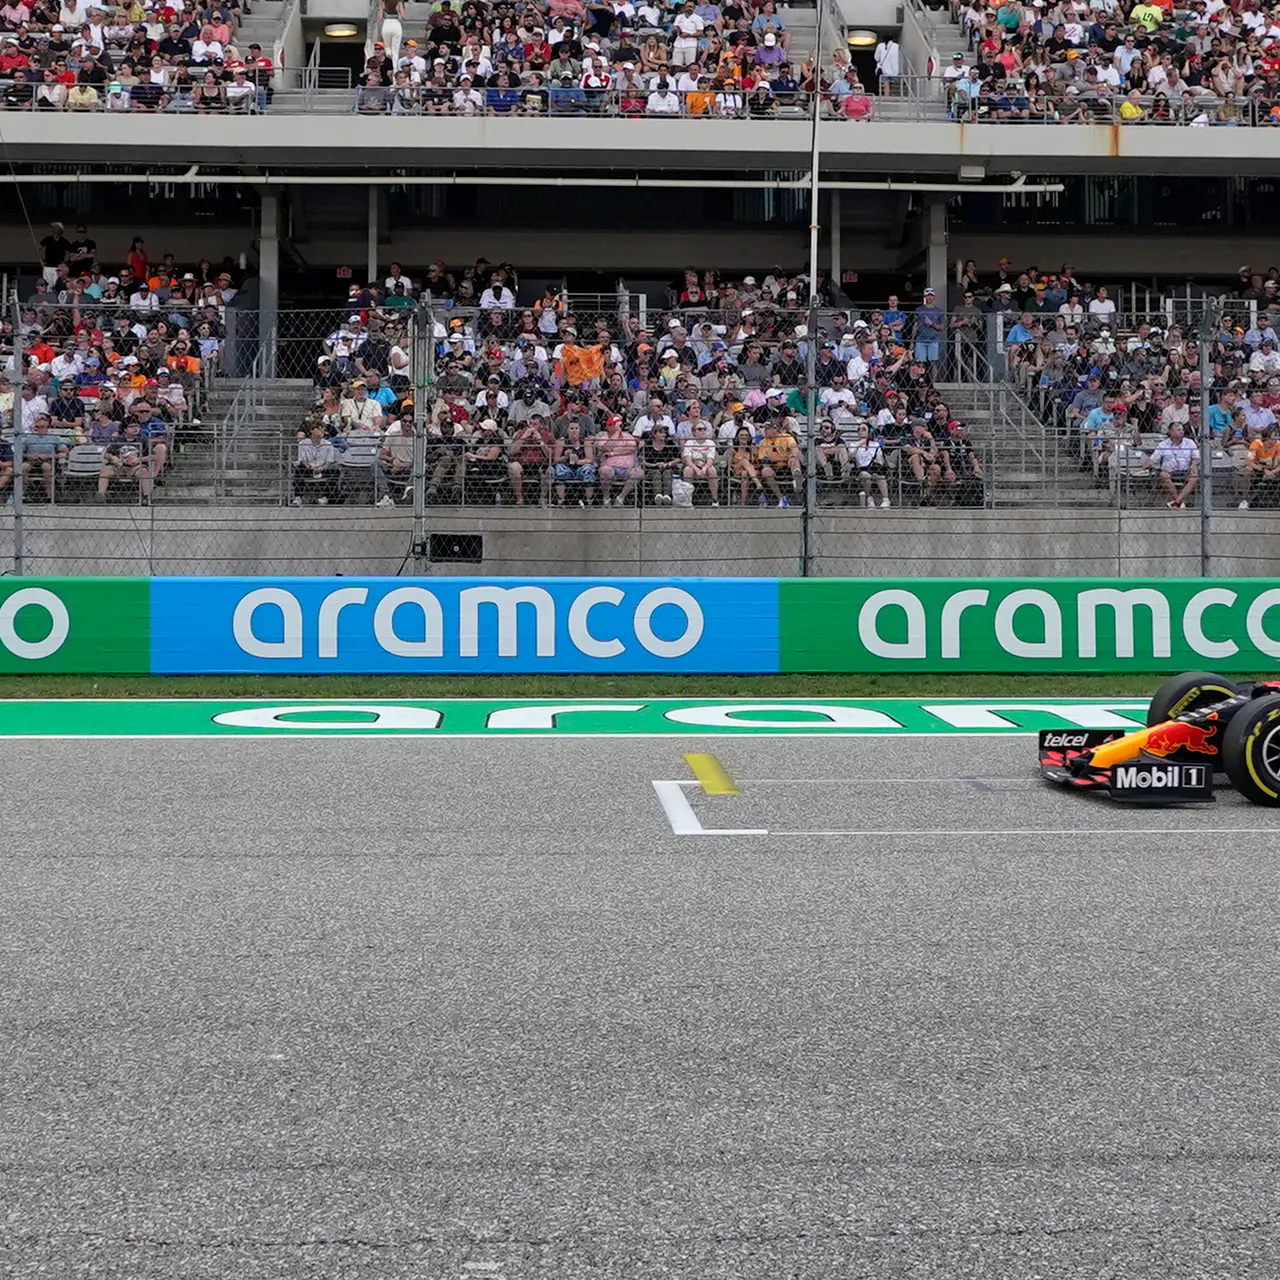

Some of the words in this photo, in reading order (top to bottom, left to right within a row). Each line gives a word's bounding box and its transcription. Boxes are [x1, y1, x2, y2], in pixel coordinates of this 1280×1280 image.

[233, 586, 704, 658] aramco
[211, 704, 1151, 730] aram
[1043, 732, 1089, 747] telcel
[1116, 766, 1179, 788] Mobil
